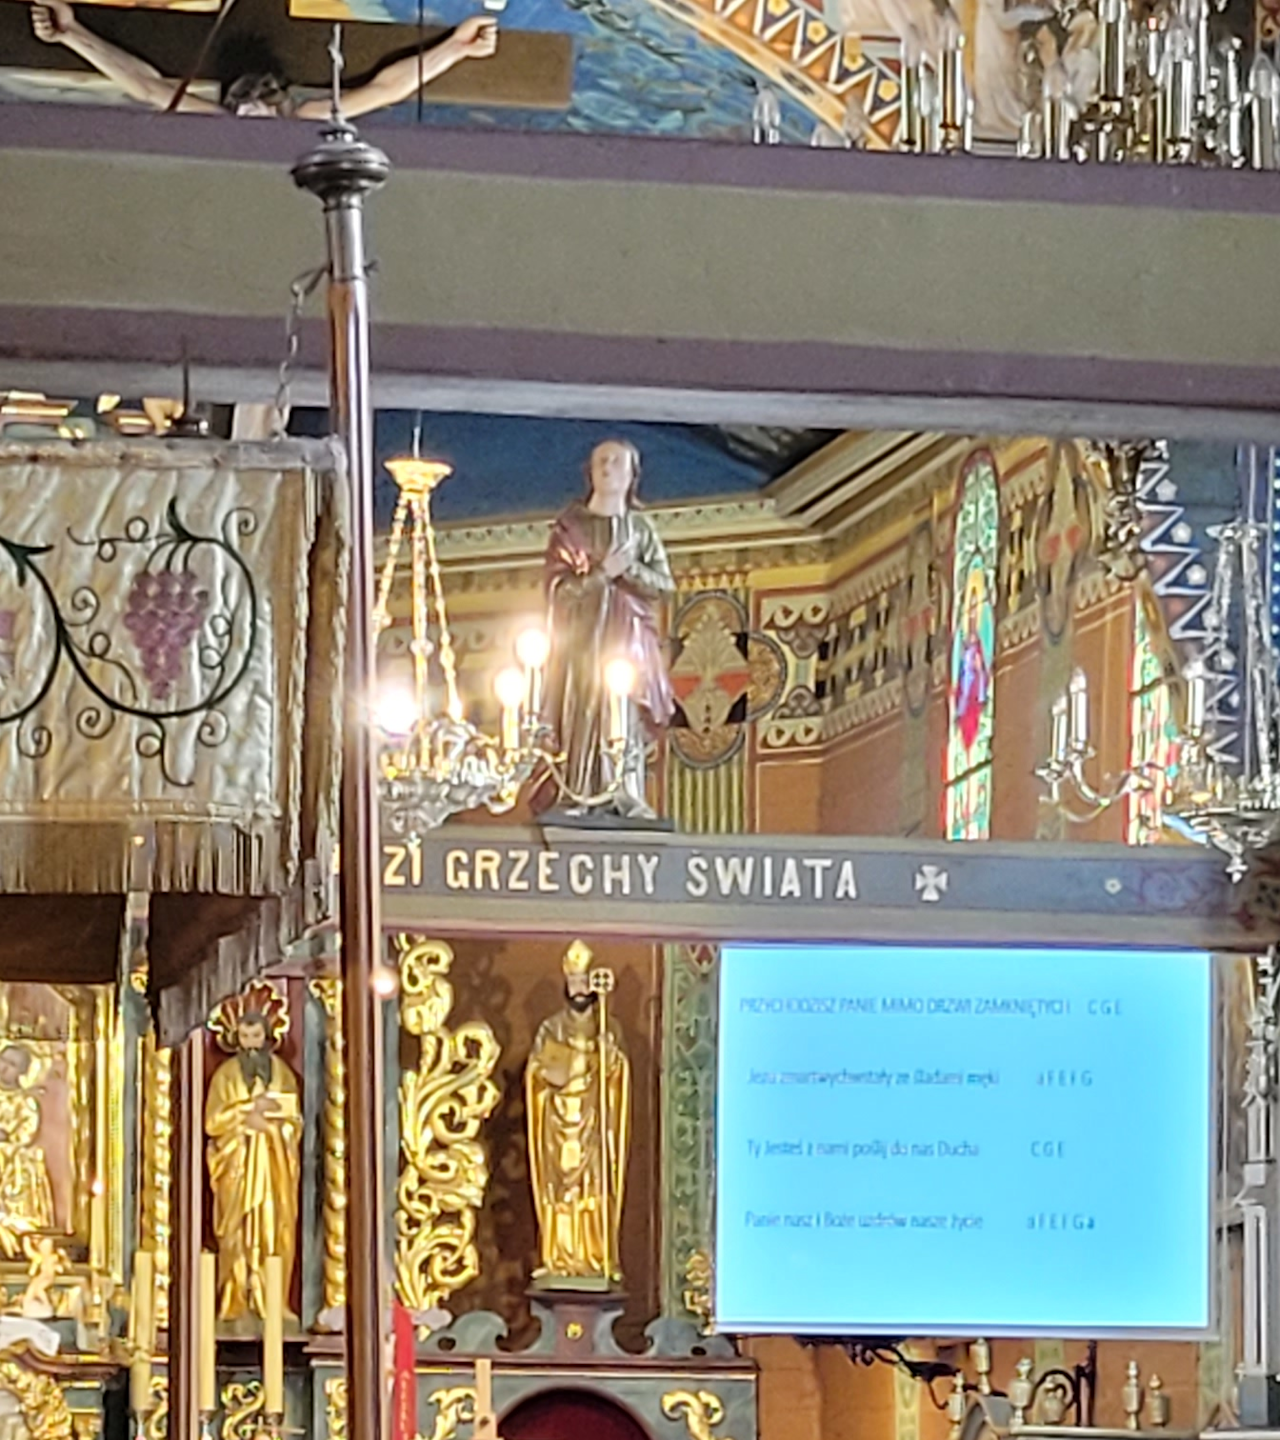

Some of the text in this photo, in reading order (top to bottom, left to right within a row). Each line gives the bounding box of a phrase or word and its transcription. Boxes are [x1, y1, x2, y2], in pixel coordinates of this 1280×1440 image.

[382, 844, 858, 898] ZI GRZECHY ŚWIATA
